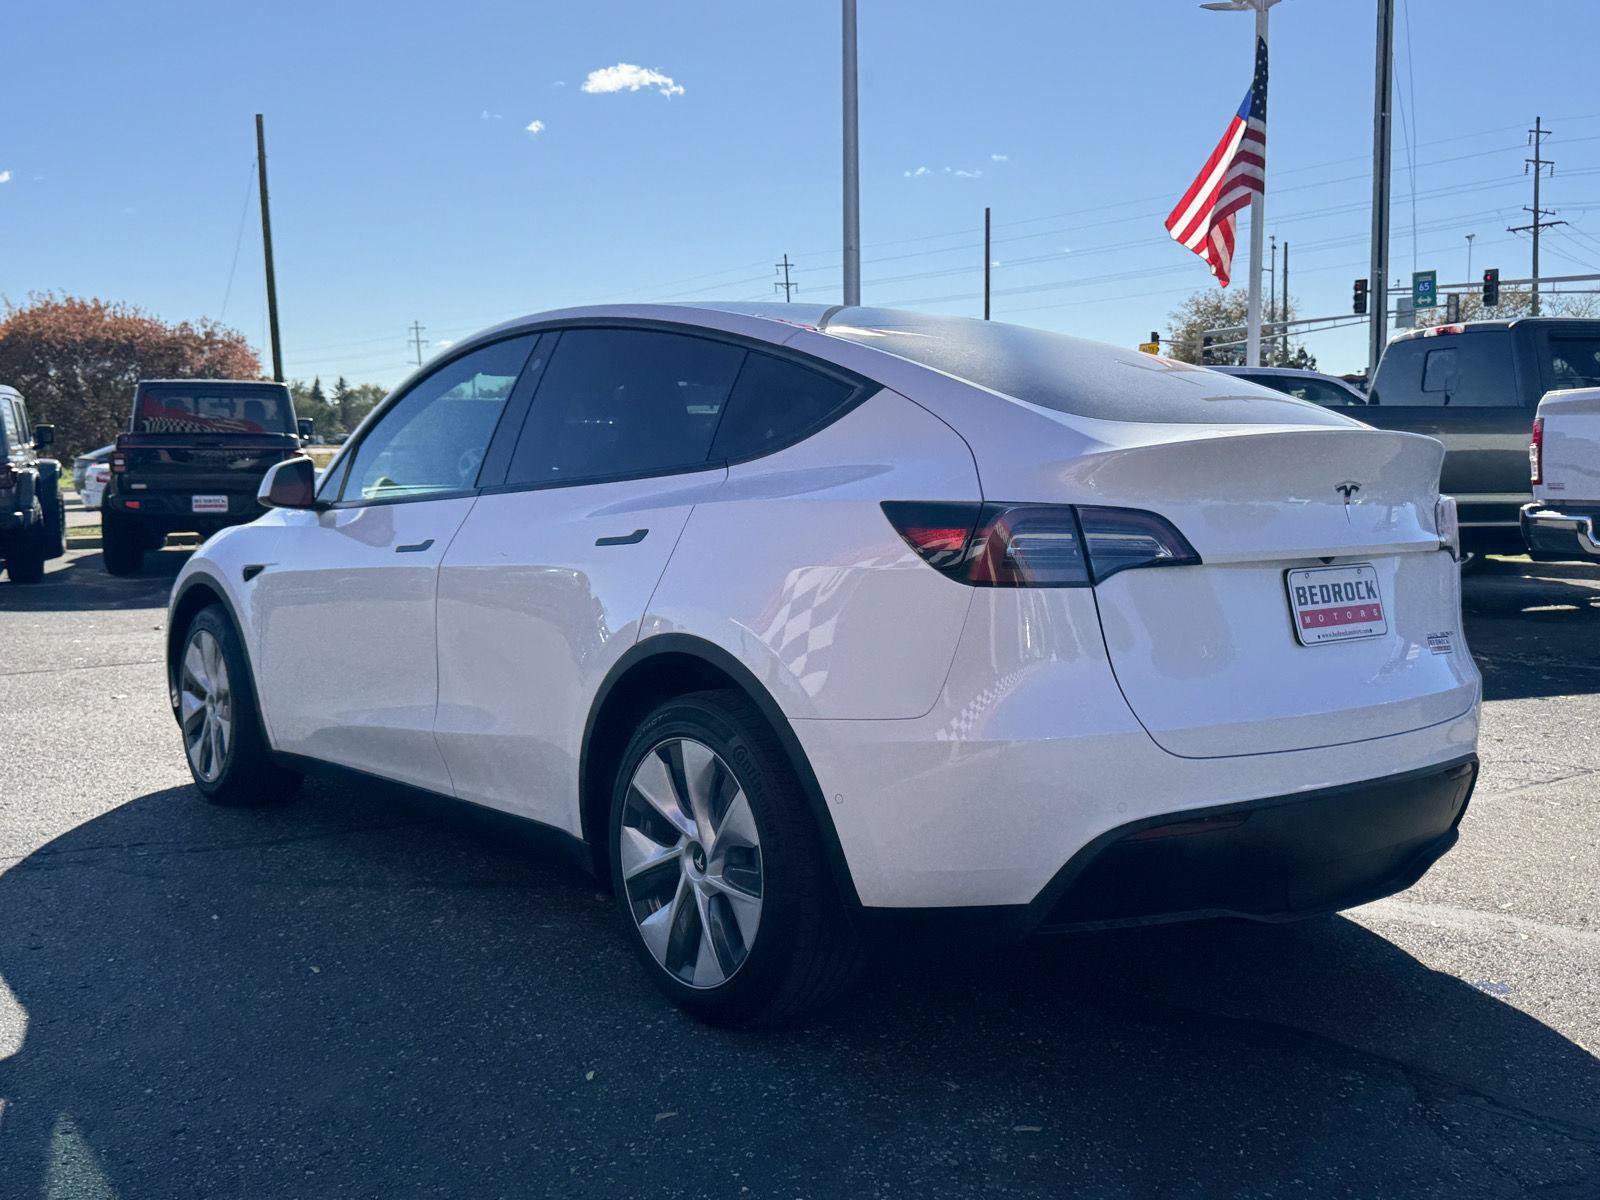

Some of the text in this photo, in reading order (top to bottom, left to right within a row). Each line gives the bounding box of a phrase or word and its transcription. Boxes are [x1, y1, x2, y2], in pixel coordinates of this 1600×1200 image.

[1418, 282, 1430, 292] 65
[1295, 580, 1377, 606] BEDROCK
[1304, 608, 1378, 624] MOTORS
